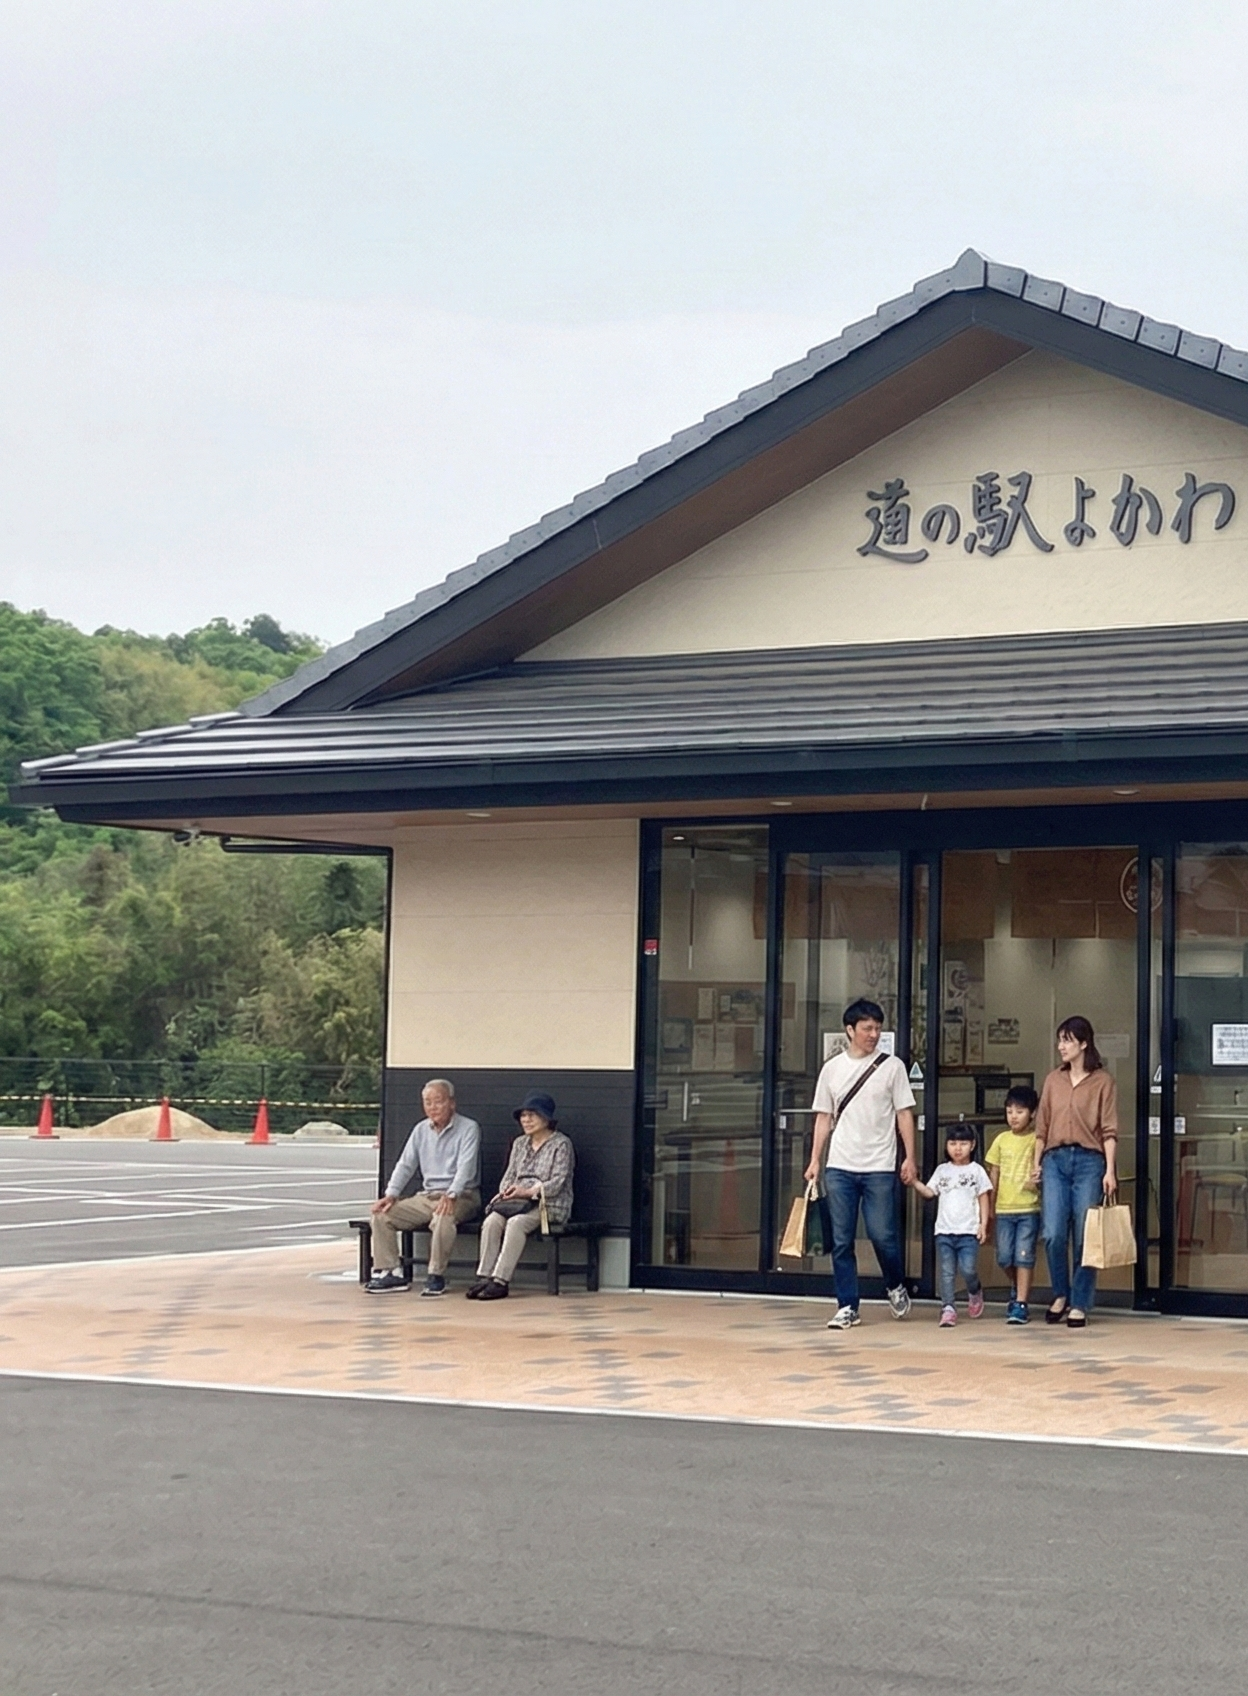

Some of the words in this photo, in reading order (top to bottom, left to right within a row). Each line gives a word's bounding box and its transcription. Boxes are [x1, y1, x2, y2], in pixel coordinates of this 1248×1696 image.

[857, 471, 1236, 563] 道の駅よかわ
